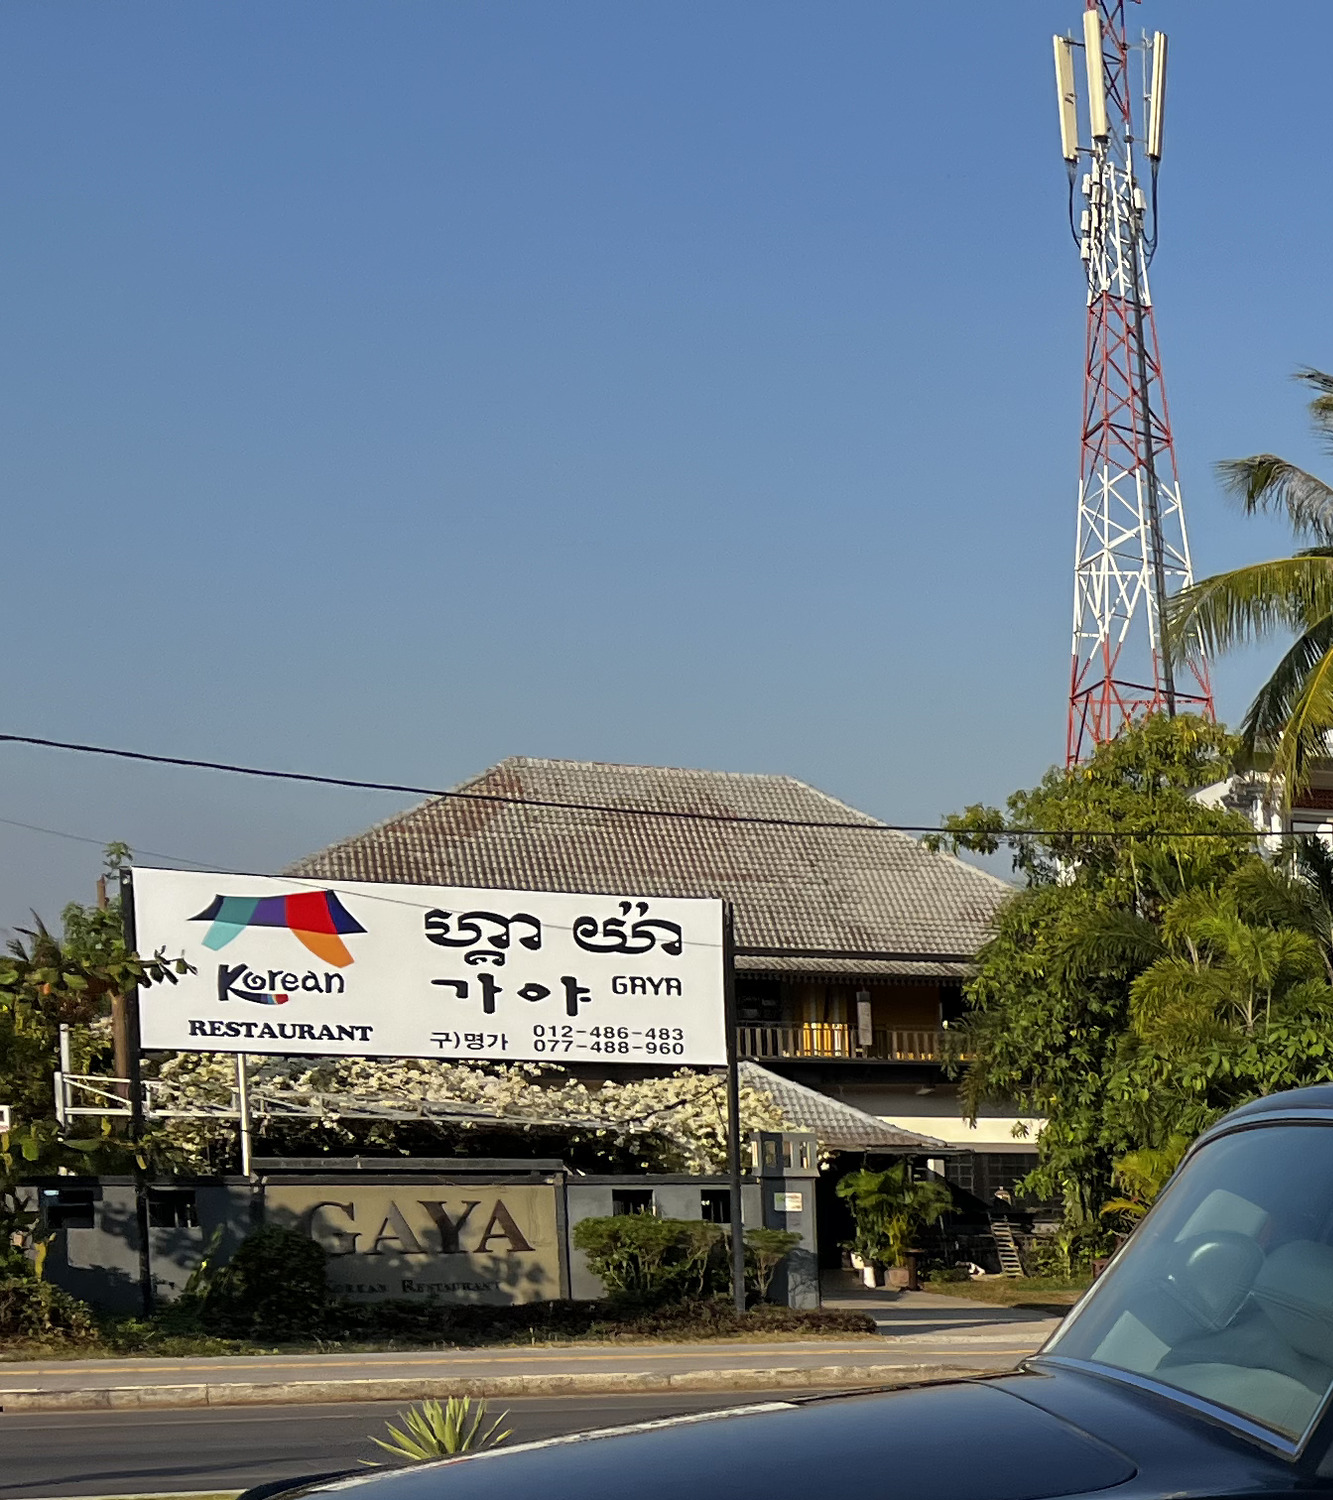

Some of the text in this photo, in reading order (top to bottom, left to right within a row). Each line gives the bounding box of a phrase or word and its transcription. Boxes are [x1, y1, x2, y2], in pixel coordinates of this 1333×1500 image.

[217, 963, 345, 1005] Korean
[431, 972, 592, 1017] 가야
[612, 975, 682, 997] GAYA
[188, 1019, 374, 1042] RESTAURANT
[532, 1024, 685, 1041] 012-486-483
[533, 1039, 685, 1055] 077-488-960
[308, 1199, 536, 1255] GAYA
